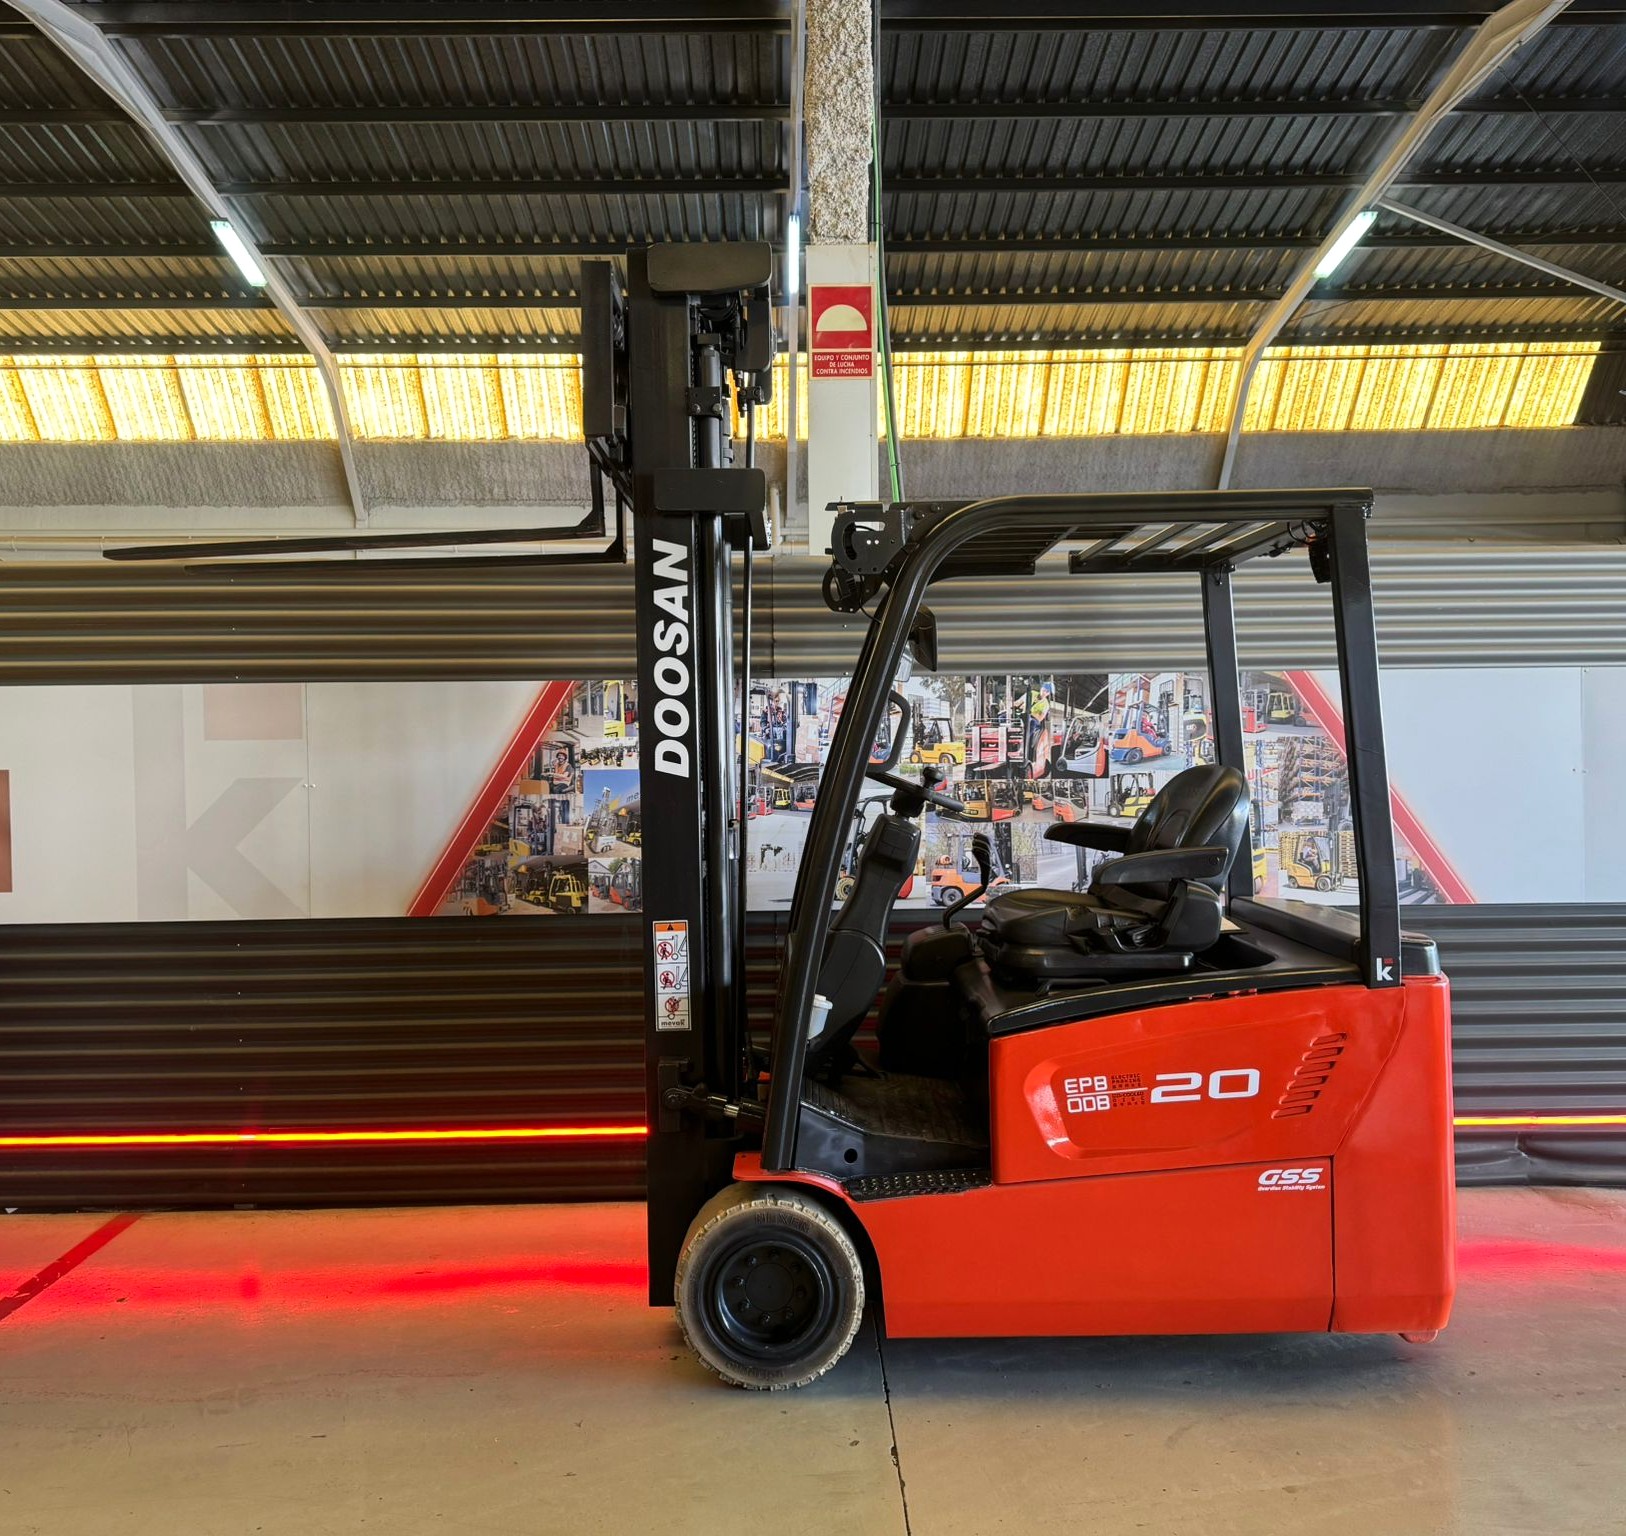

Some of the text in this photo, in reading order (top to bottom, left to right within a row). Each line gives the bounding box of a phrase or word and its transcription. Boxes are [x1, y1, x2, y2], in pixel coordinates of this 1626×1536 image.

[652, 538, 690, 778] DOOSAN
[1064, 1075, 1108, 1094] EPB
[1150, 1068, 1261, 1104] 20
[1258, 1168, 1324, 1185] GSS
